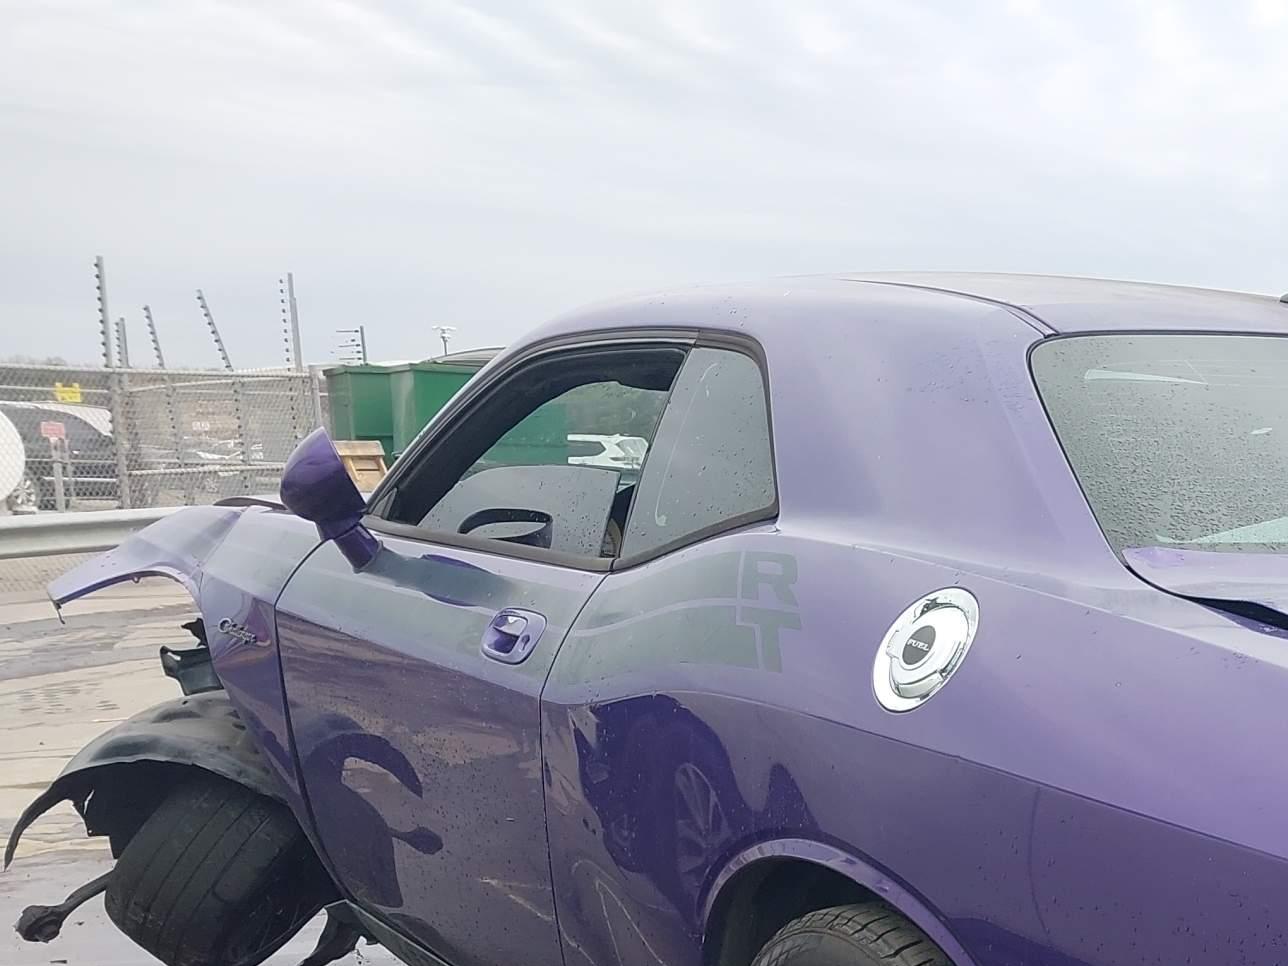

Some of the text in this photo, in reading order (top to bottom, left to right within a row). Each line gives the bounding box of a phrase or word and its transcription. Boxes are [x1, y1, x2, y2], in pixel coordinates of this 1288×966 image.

[741, 552, 799, 608] R
[741, 606, 802, 674] T
[907, 638, 930, 651] FUEL
